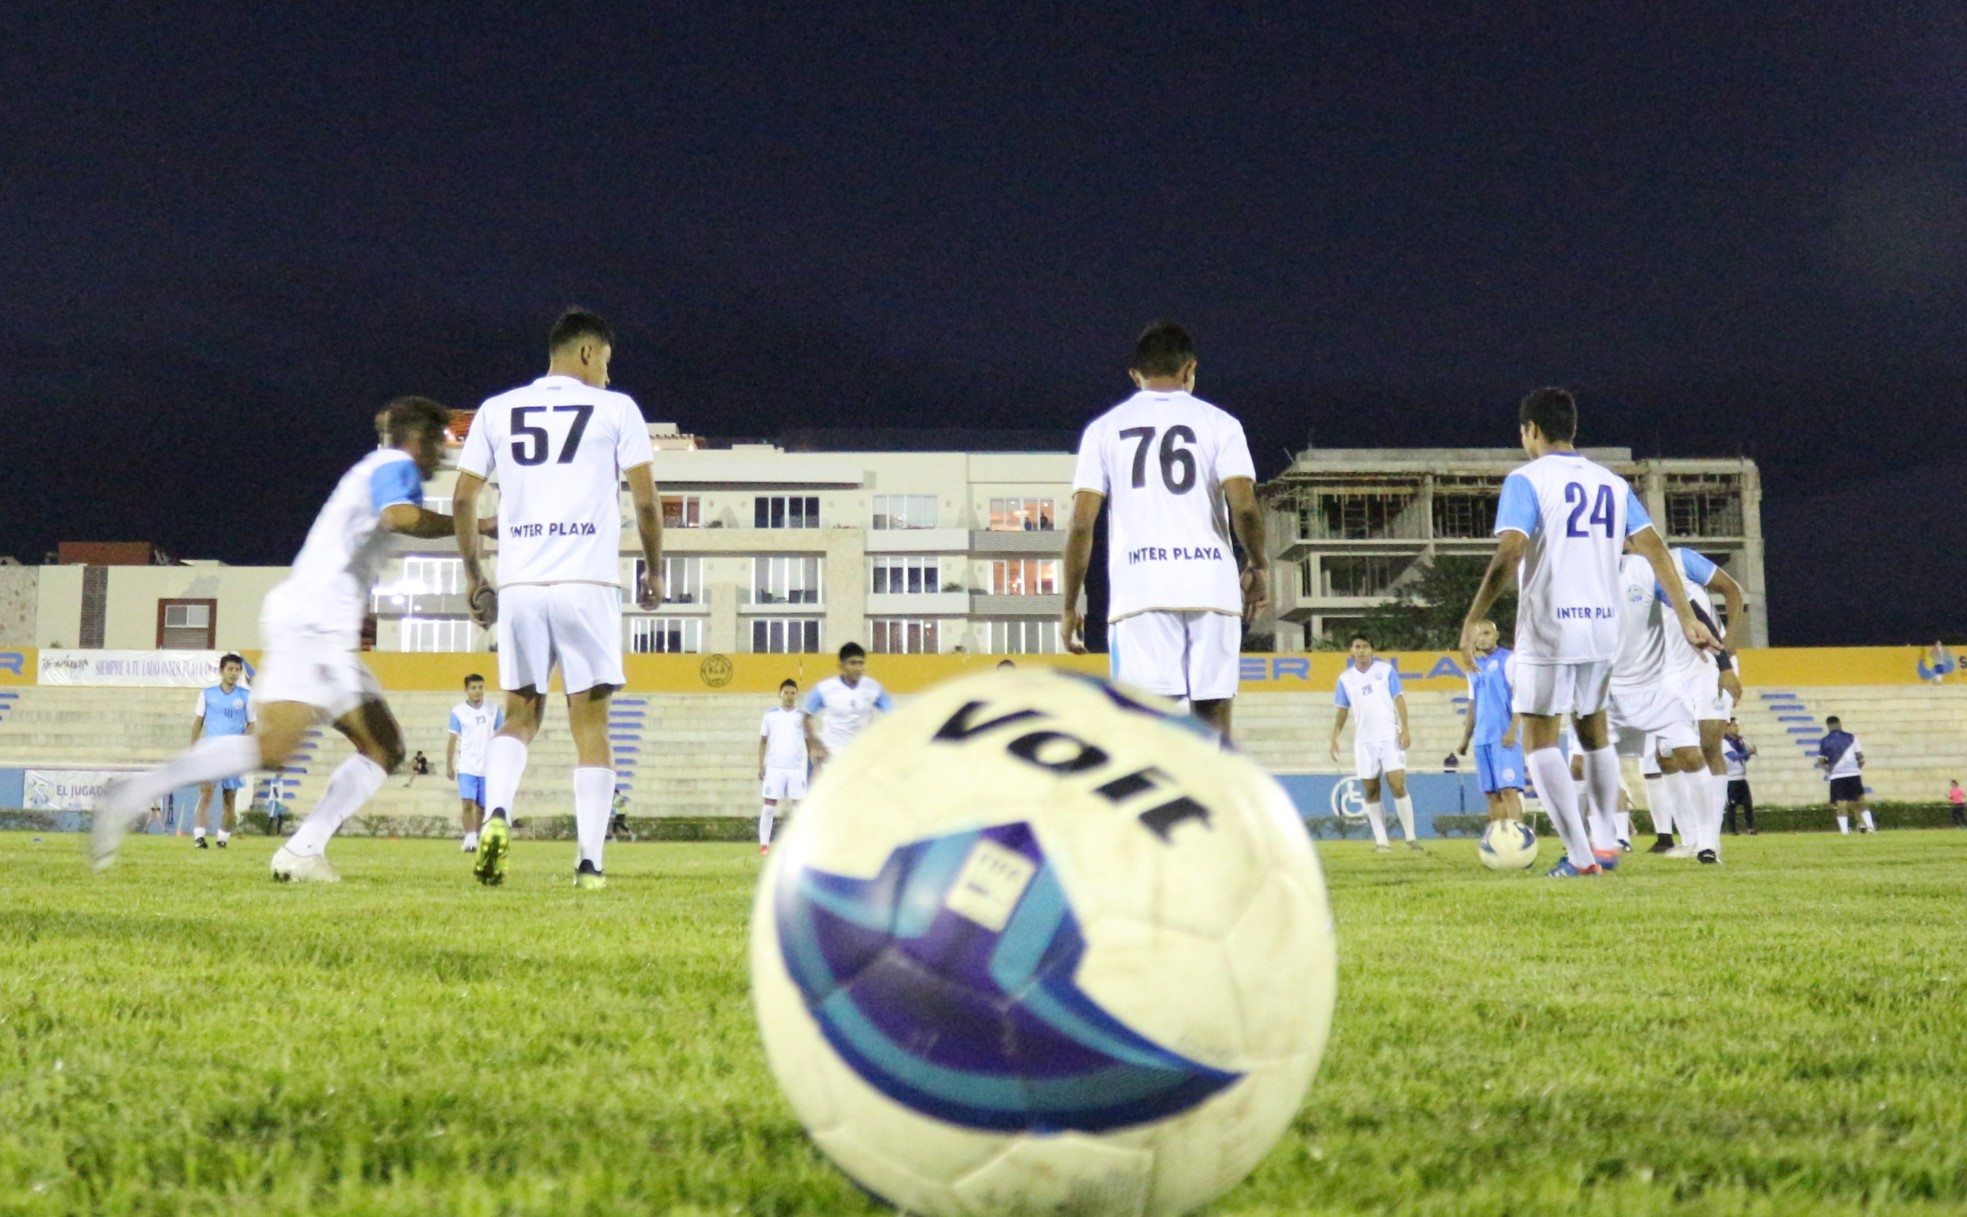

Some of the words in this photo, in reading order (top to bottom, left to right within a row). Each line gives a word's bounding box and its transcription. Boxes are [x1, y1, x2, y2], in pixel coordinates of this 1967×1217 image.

[511, 404, 594, 466] 57
[1118, 424, 1198, 495] 76
[1564, 481, 1616, 538] 24
[510, 523, 543, 539] INTER
[549, 522, 597, 536] PLAYA
[1128, 546, 1168, 565] INTER
[1173, 546, 1223, 561] PLAYA
[1557, 606, 1592, 620] INTER
[1595, 606, 1616, 619] PLA
[56, 784, 68, 796] EL
[70, 784, 105, 798] JUGAD
